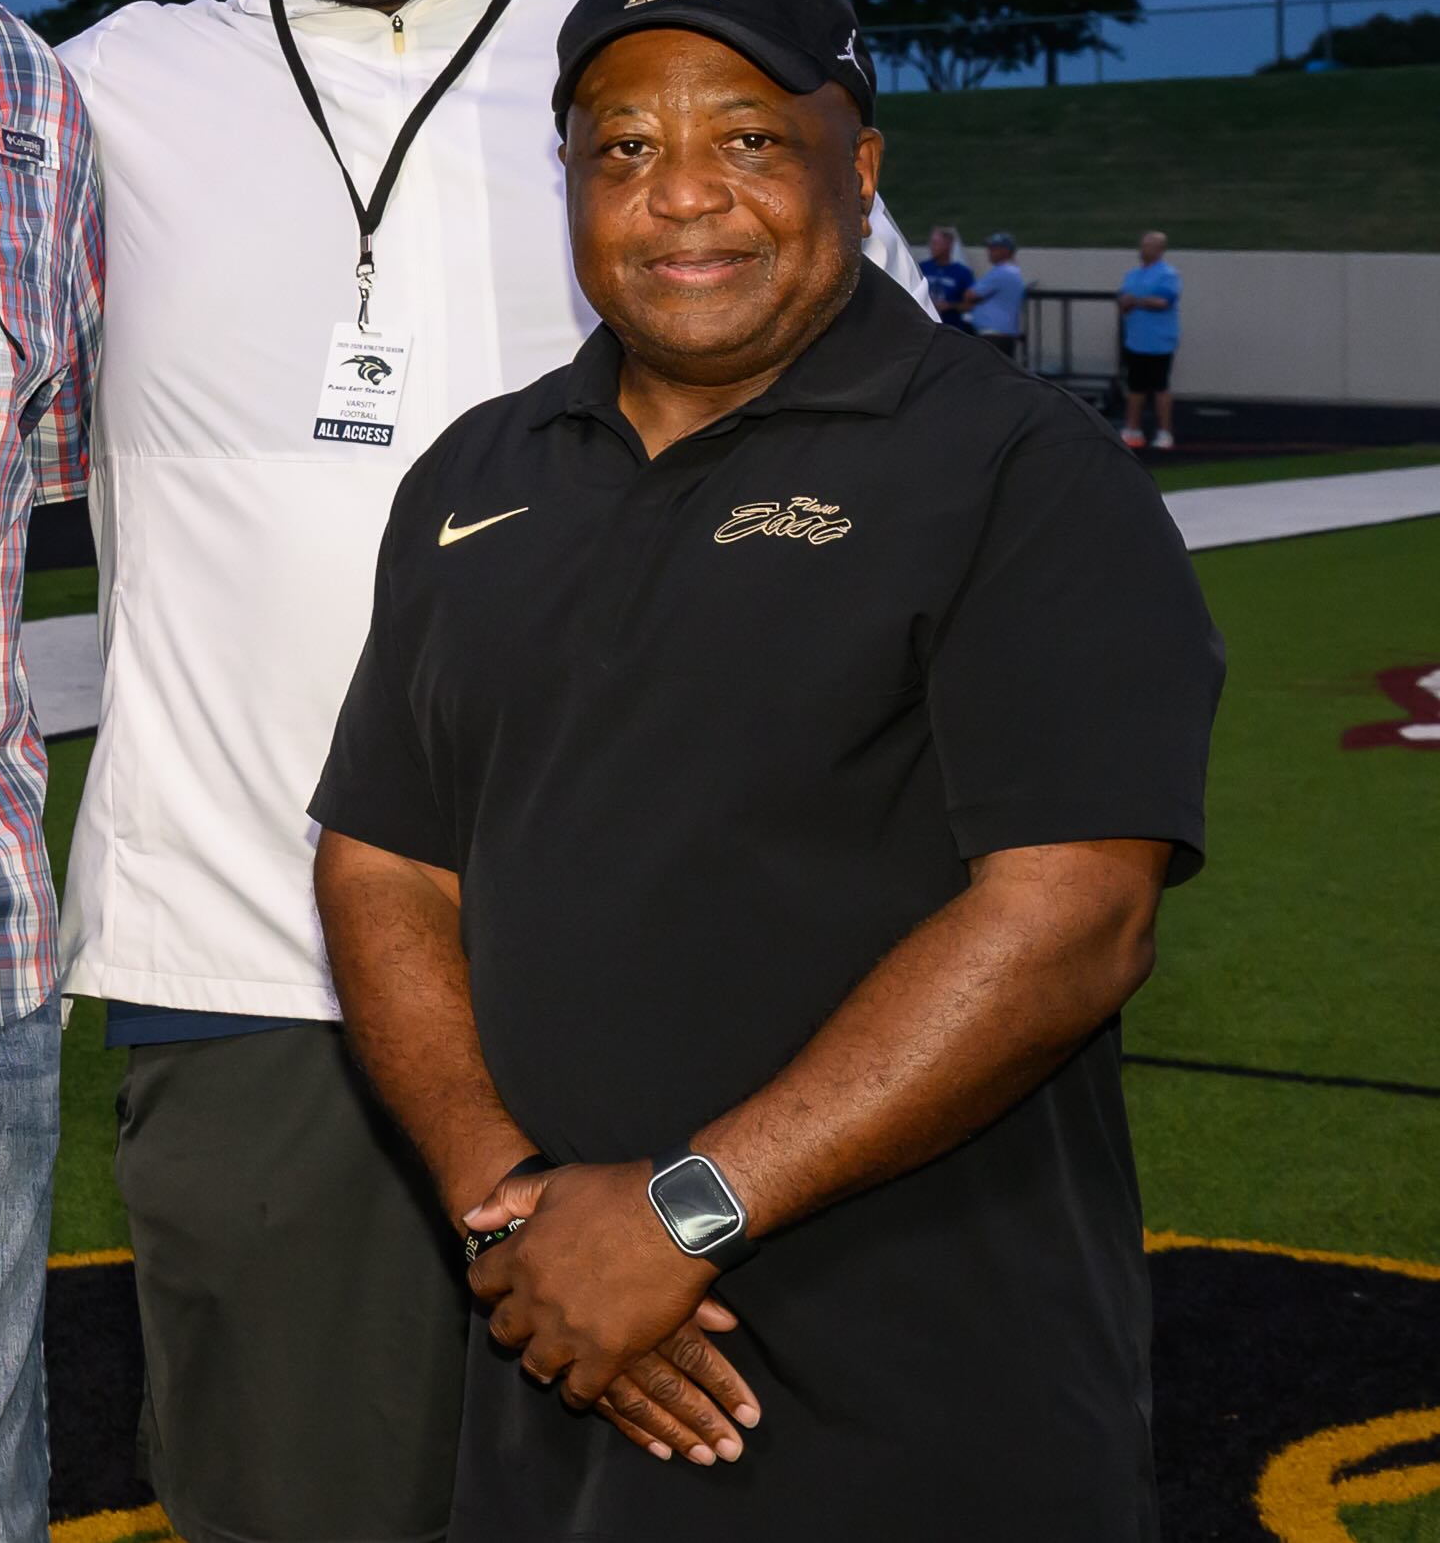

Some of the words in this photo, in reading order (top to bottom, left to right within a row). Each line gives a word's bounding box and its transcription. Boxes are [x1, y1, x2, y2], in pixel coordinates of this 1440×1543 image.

[346, 399, 376, 409] VARSITY
[340, 410, 377, 420] FOOTBALL
[317, 422, 339, 438] ALL
[342, 424, 390, 443] ACCESS
[787, 496, 840, 515] Plano
[714, 502, 852, 545] East
